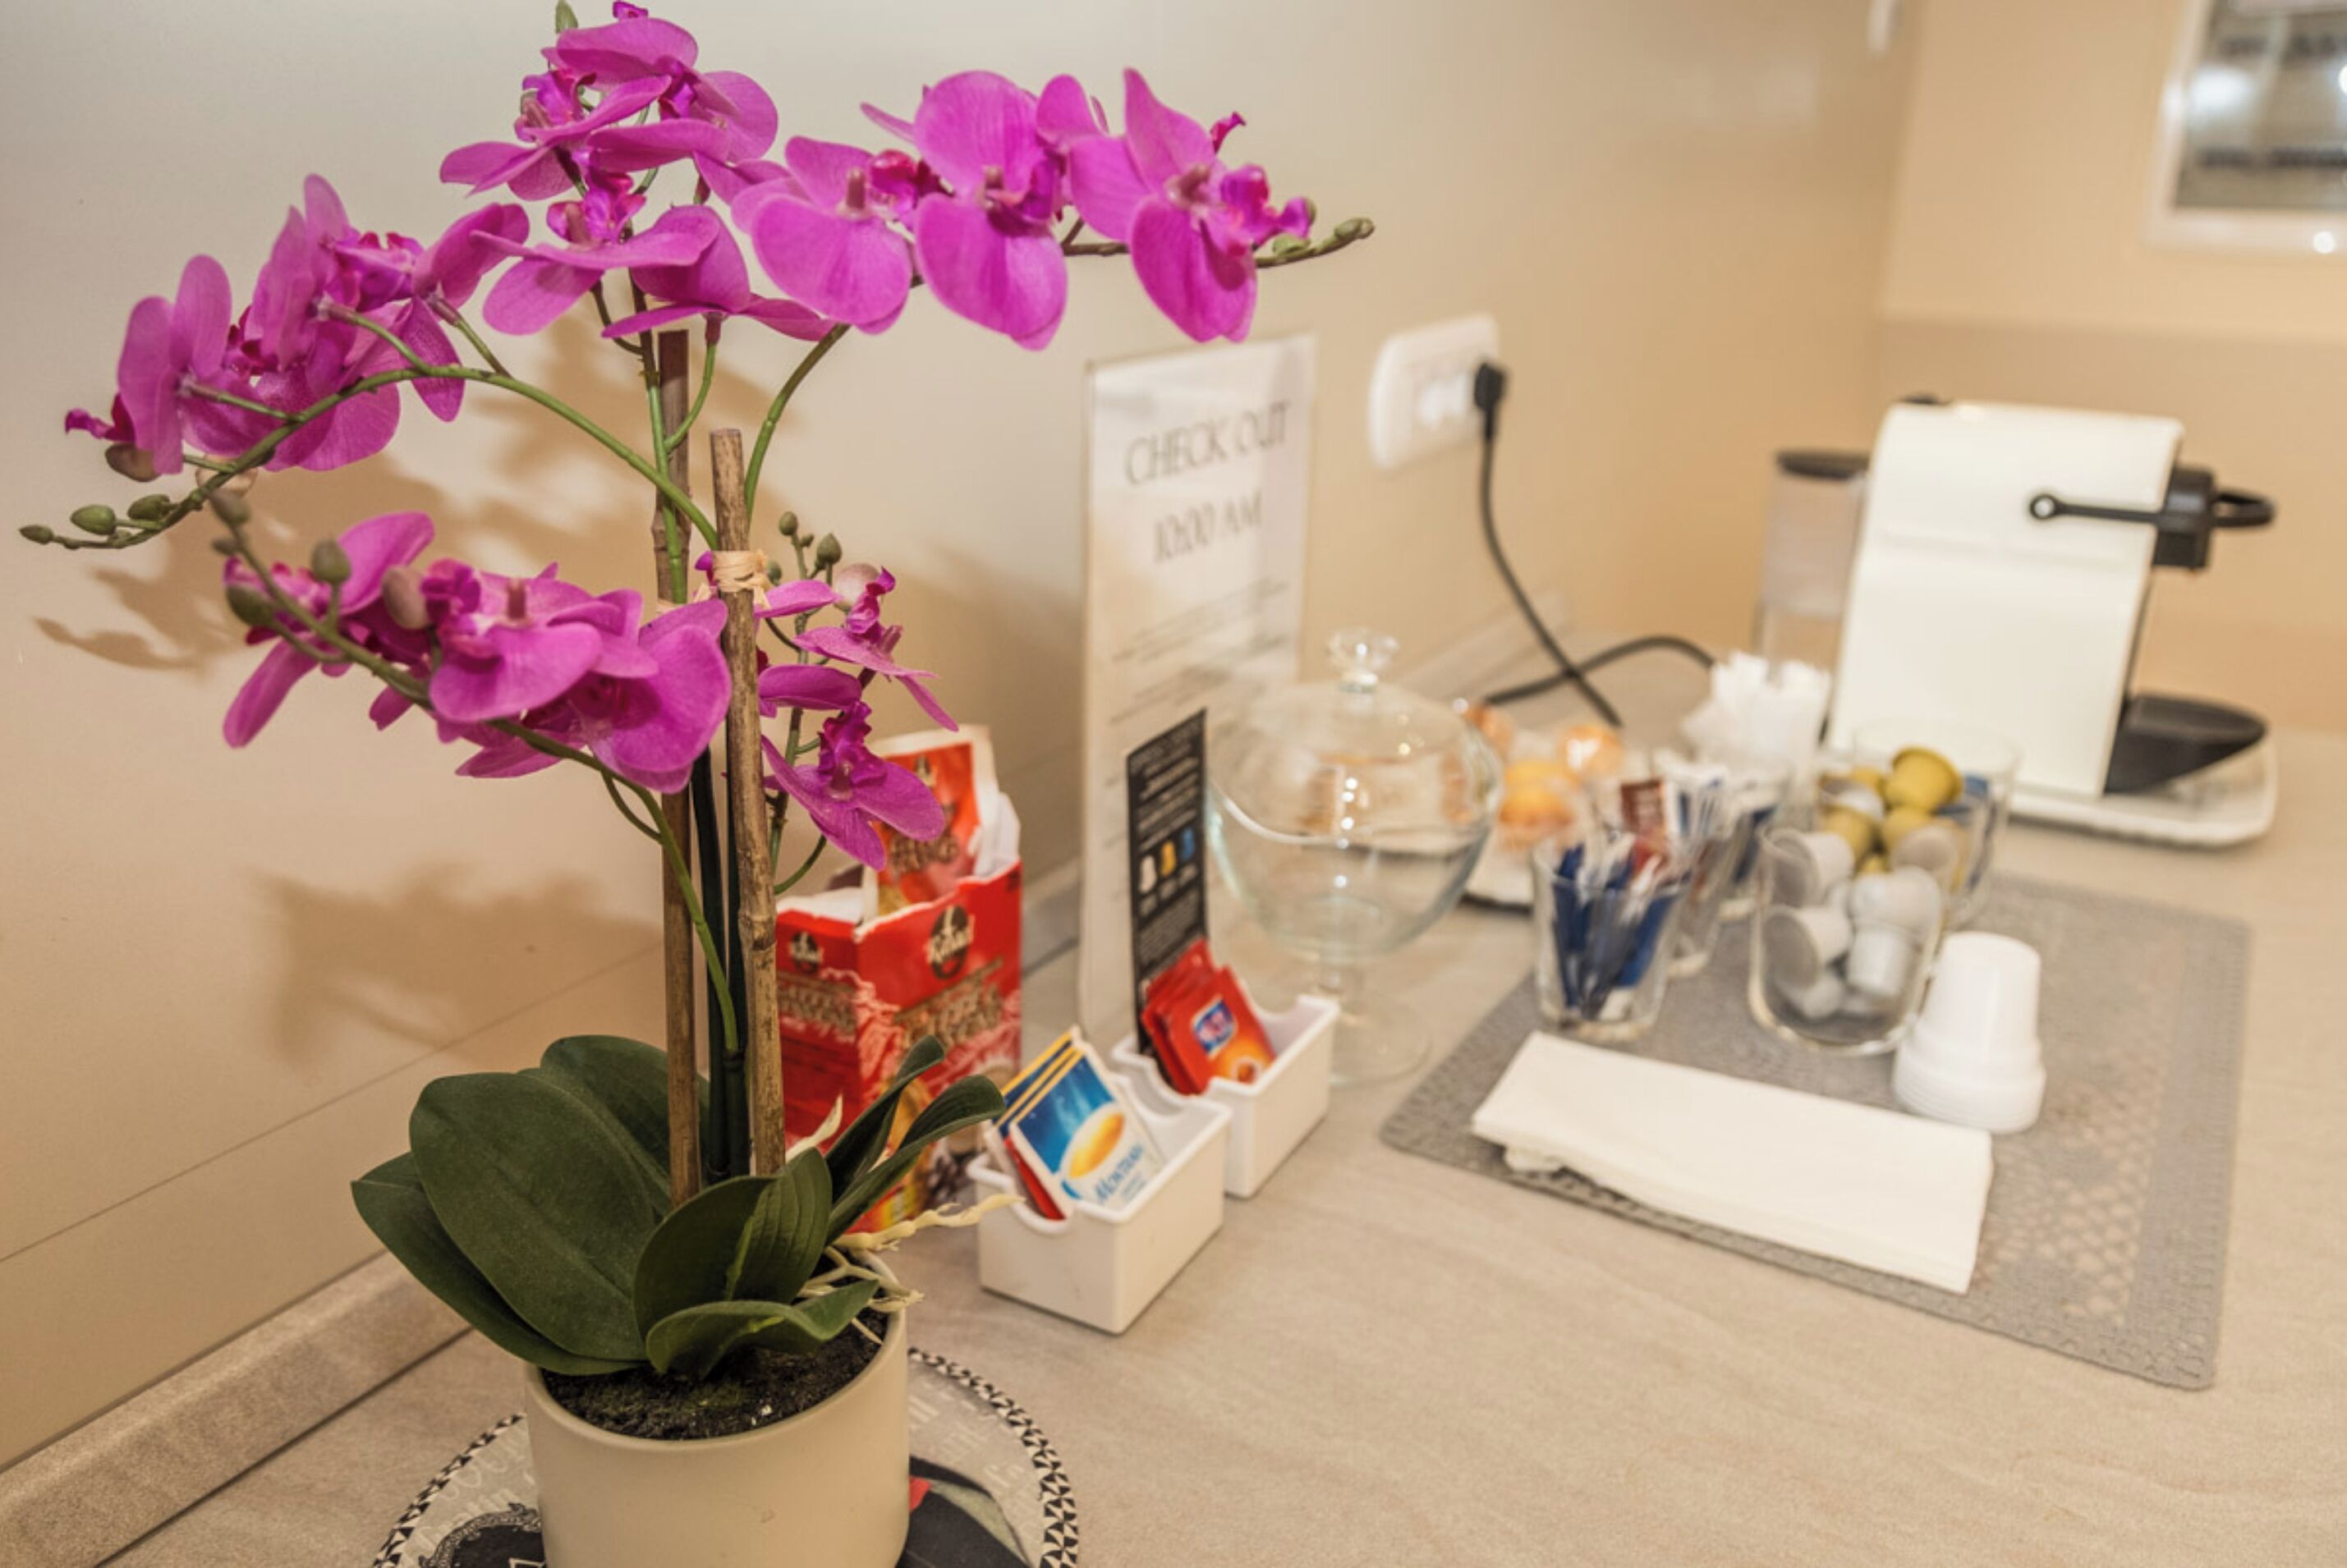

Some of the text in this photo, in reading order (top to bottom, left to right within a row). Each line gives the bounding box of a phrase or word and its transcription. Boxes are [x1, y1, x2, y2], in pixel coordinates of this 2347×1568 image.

[1125, 401, 1290, 485] CHECK OUT
[1225, 489, 1262, 534] AM
